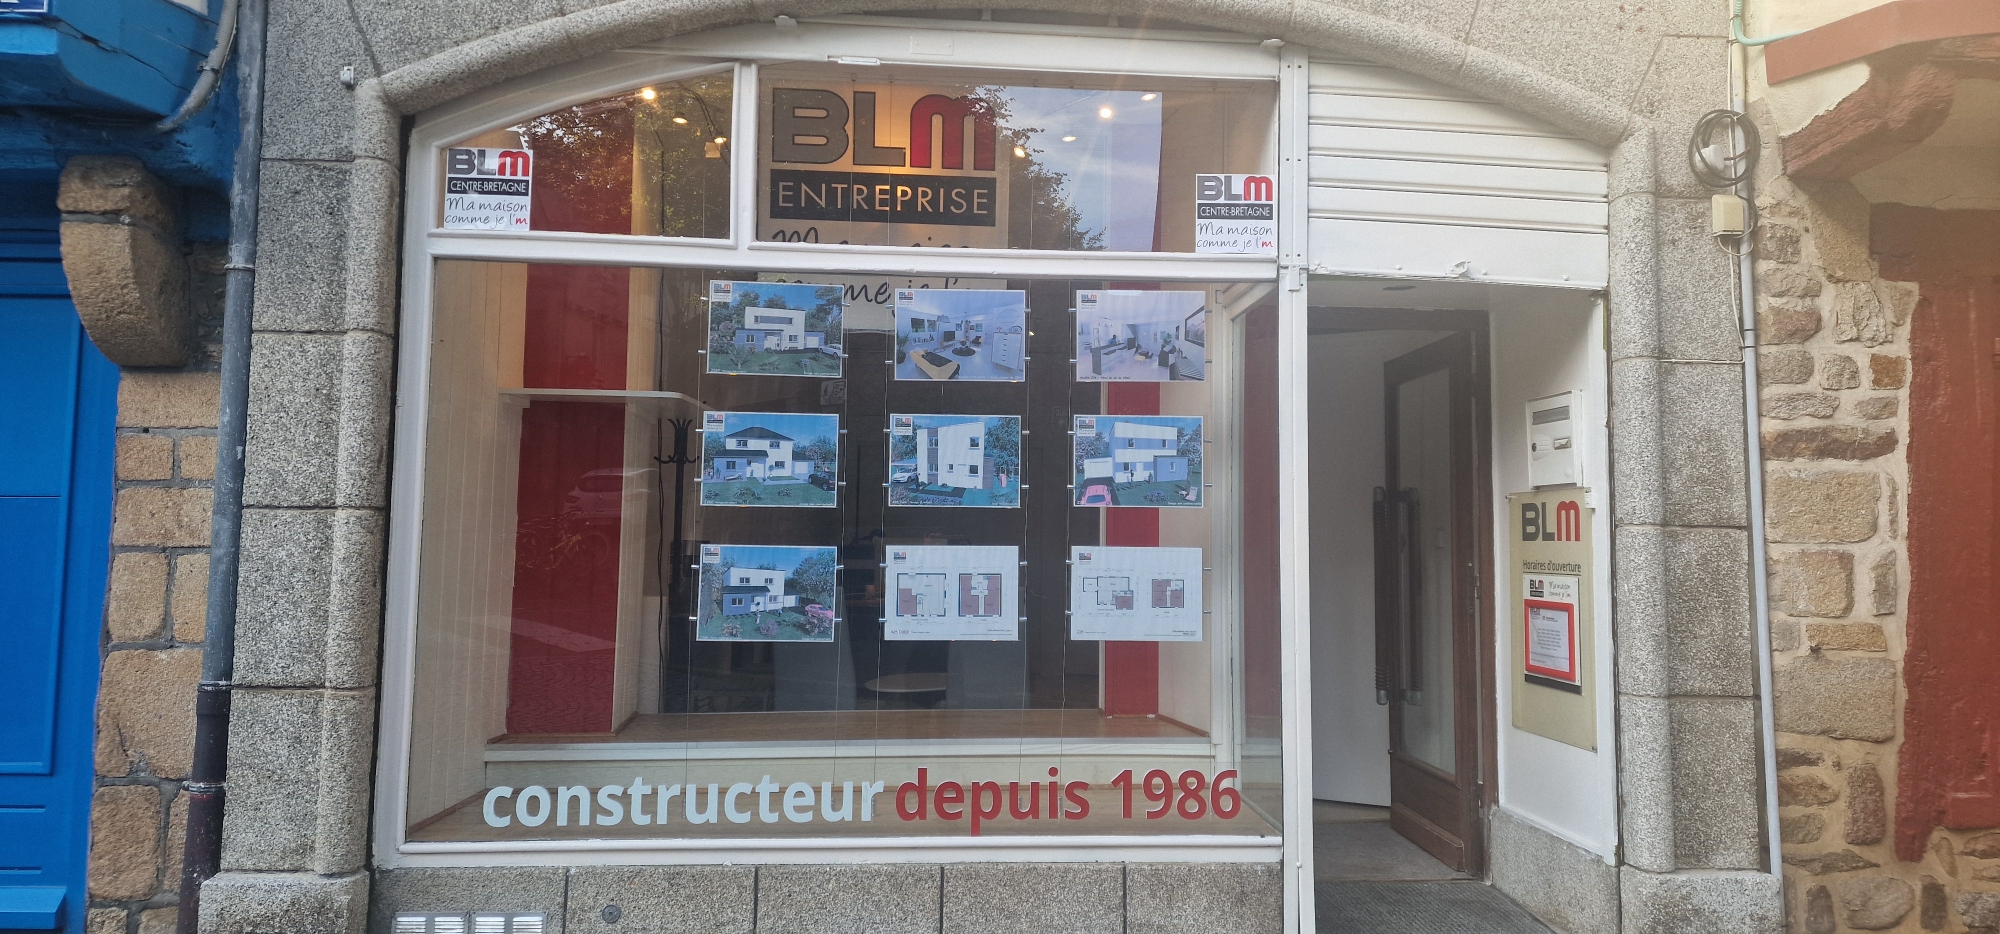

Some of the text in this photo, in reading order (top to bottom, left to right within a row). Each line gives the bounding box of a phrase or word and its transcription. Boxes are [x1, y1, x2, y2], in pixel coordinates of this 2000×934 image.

[450, 180, 527, 193] CENTRE-BRETAGNE
[446, 196, 528, 212] Ma maison
[777, 181, 989, 215] ENTREPRISE
[1200, 206, 1271, 217] CENTRE-BRETAGNE
[444, 214, 490, 225] comme
[490, 214, 505, 230] je
[1197, 221, 1274, 236] Ma maison
[1196, 239, 1238, 248] comme
[1238, 238, 1252, 252] je
[1522, 559, 1582, 573] Horaires d'ouverture
[482, 766, 1242, 836] constructeur depuis 1986
